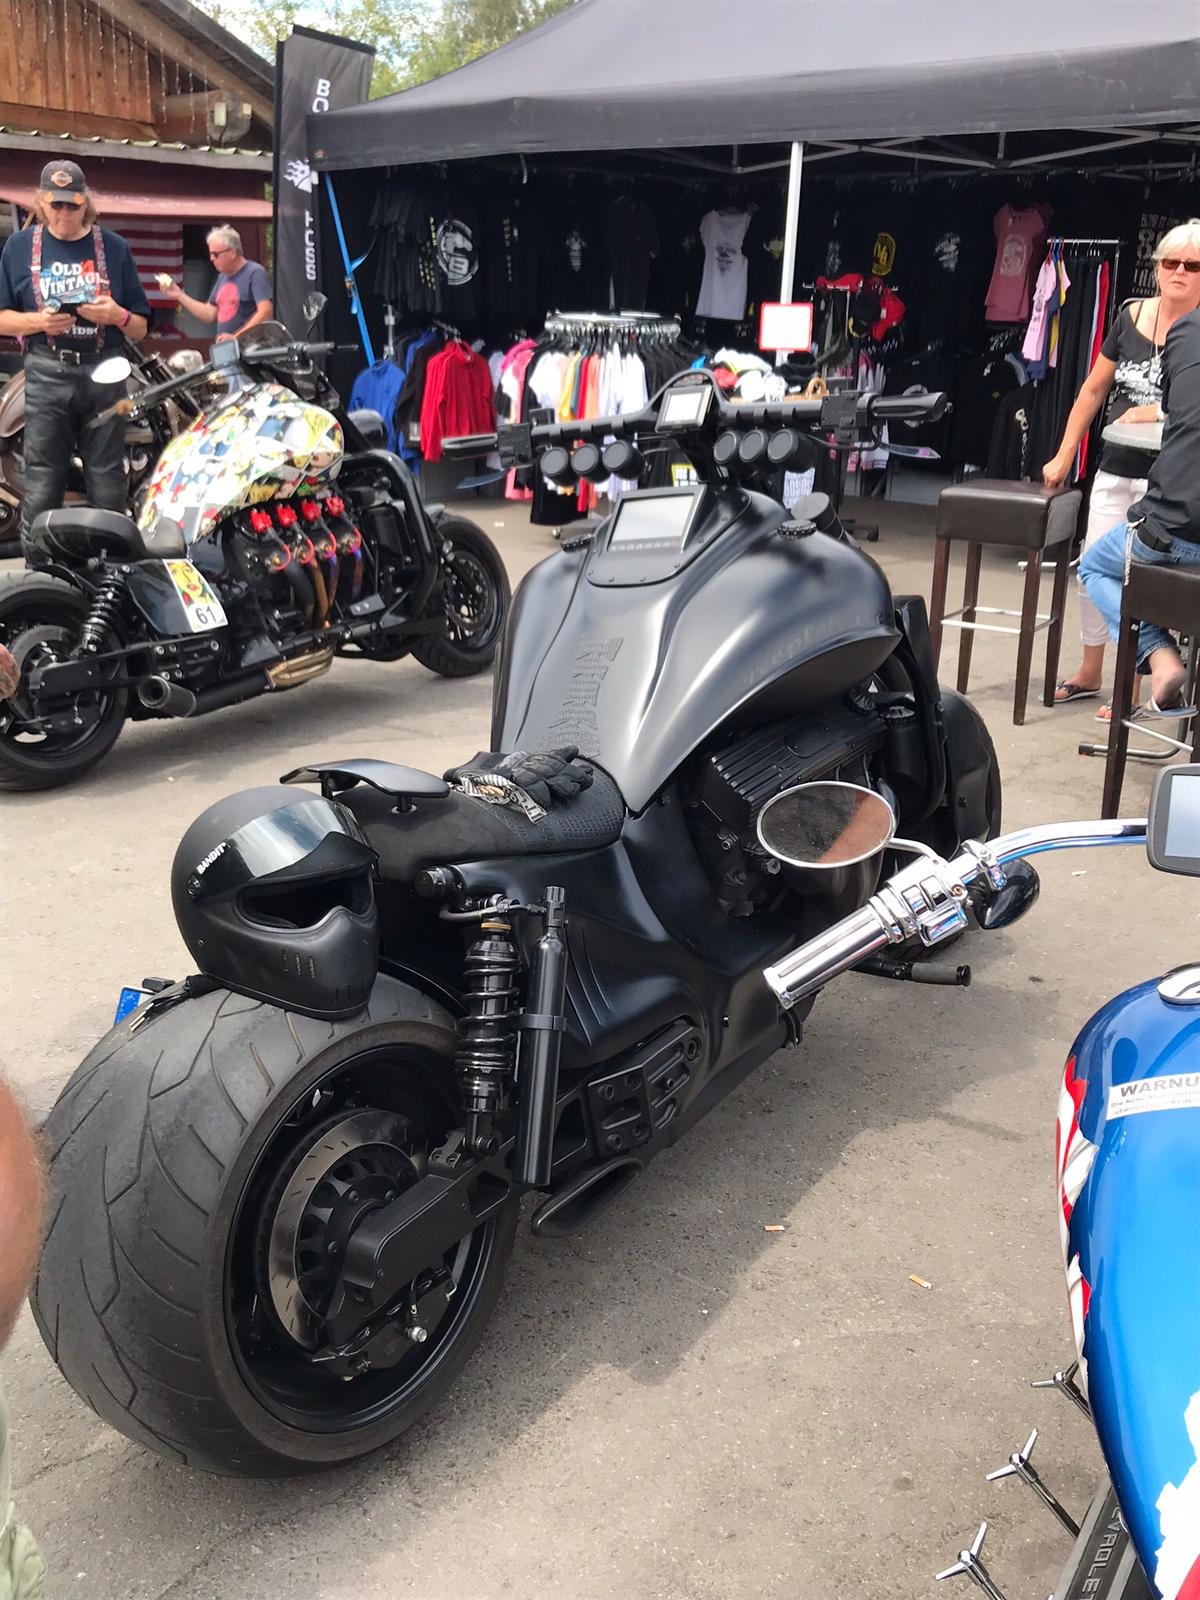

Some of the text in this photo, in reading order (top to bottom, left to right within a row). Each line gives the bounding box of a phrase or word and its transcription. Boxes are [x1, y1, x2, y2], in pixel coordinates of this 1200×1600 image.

[51, 261, 82, 276] OLD
[195, 605, 217, 625] 61
[196, 841, 227, 875] BANDIT
